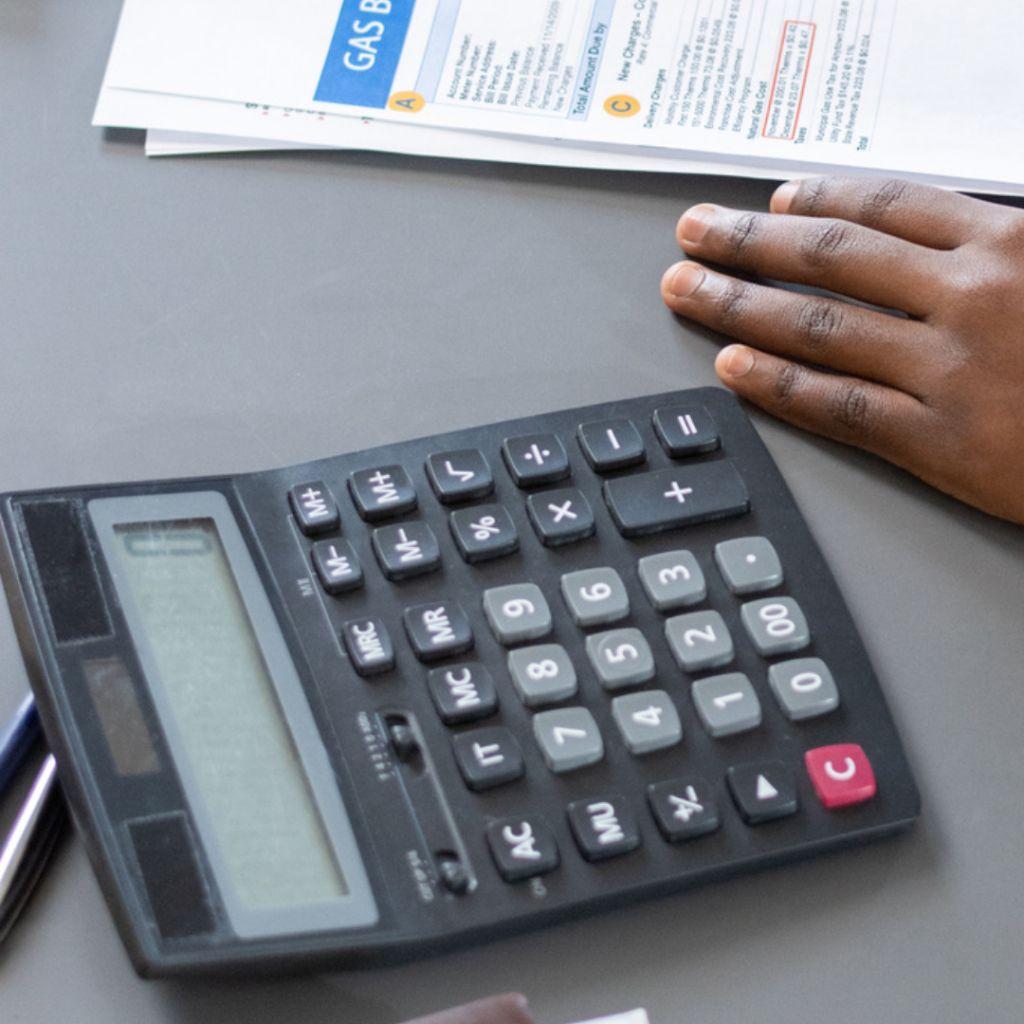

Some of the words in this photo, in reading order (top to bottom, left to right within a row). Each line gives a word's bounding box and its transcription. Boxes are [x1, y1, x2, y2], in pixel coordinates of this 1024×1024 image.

[592, 21, 607, 34] by
[622, 19, 641, 58] Charges
[342, 19, 384, 71] GAS
[548, 42, 564, 72] Balance
[587, 35, 603, 55] Due
[518, 46, 535, 75] Balance
[617, 60, 631, 81] New
[729, 47, 744, 85] Adjustment
[820, 100, 832, 113] Gas
[831, 32, 843, 61] Anytown
[446, 68, 462, 98] Account
[500, 71, 514, 91] Issue
[525, 77, 540, 108] Payment
[533, 42, 550, 76] Received
[556, 65, 573, 94] Charges
[578, 55, 597, 93] Amount
[649, 68, 666, 100] Charges
[670, 68, 685, 100] Customer
[697, 74, 711, 98] Therms
[458, 77, 472, 100] Meter
[471, 74, 487, 101] Service
[496, 92, 508, 104] Bill
[511, 76, 527, 106] Previous
[539, 73, 558, 109] Remaining
[683, 75, 697, 100] Therms
[738, 76, 752, 104] Program
[755, 80, 767, 99] Cost
[394, 97, 416, 109] A
[552, 96, 564, 111] New
[572, 94, 588, 114] Total
[610, 99, 631, 112] C
[642, 101, 659, 128] Delivery
[752, 100, 764, 114] Gas
[845, 102, 859, 129] Revenue
[747, 115, 760, 139] Natural
[794, 126, 807, 144] Taxes
[856, 135, 868, 151] Total
[369, 471, 400, 504] M+
[664, 481, 693, 503] +
[301, 487, 329, 518] M+
[470, 515, 500, 541] %
[394, 528, 423, 563] M-
[326, 545, 353, 577] M-
[658, 564, 691, 586] 3
[579, 582, 612, 602] 6
[503, 598, 535, 618] 9
[759, 603, 796, 637] 00
[423, 606, 456, 644] MR
[683, 624, 717, 646] 2
[352, 621, 385, 661] MRC
[604, 643, 639, 664] 5
[526, 659, 559, 680] 8
[445, 667, 481, 708] MC
[790, 672, 823, 693] 0
[712, 691, 744, 709] 1
[632, 705, 663, 726] 4
[552, 726, 587, 745] 7
[824, 756, 857, 781] C
[586, 801, 625, 845] MU
[501, 821, 542, 861] AC
